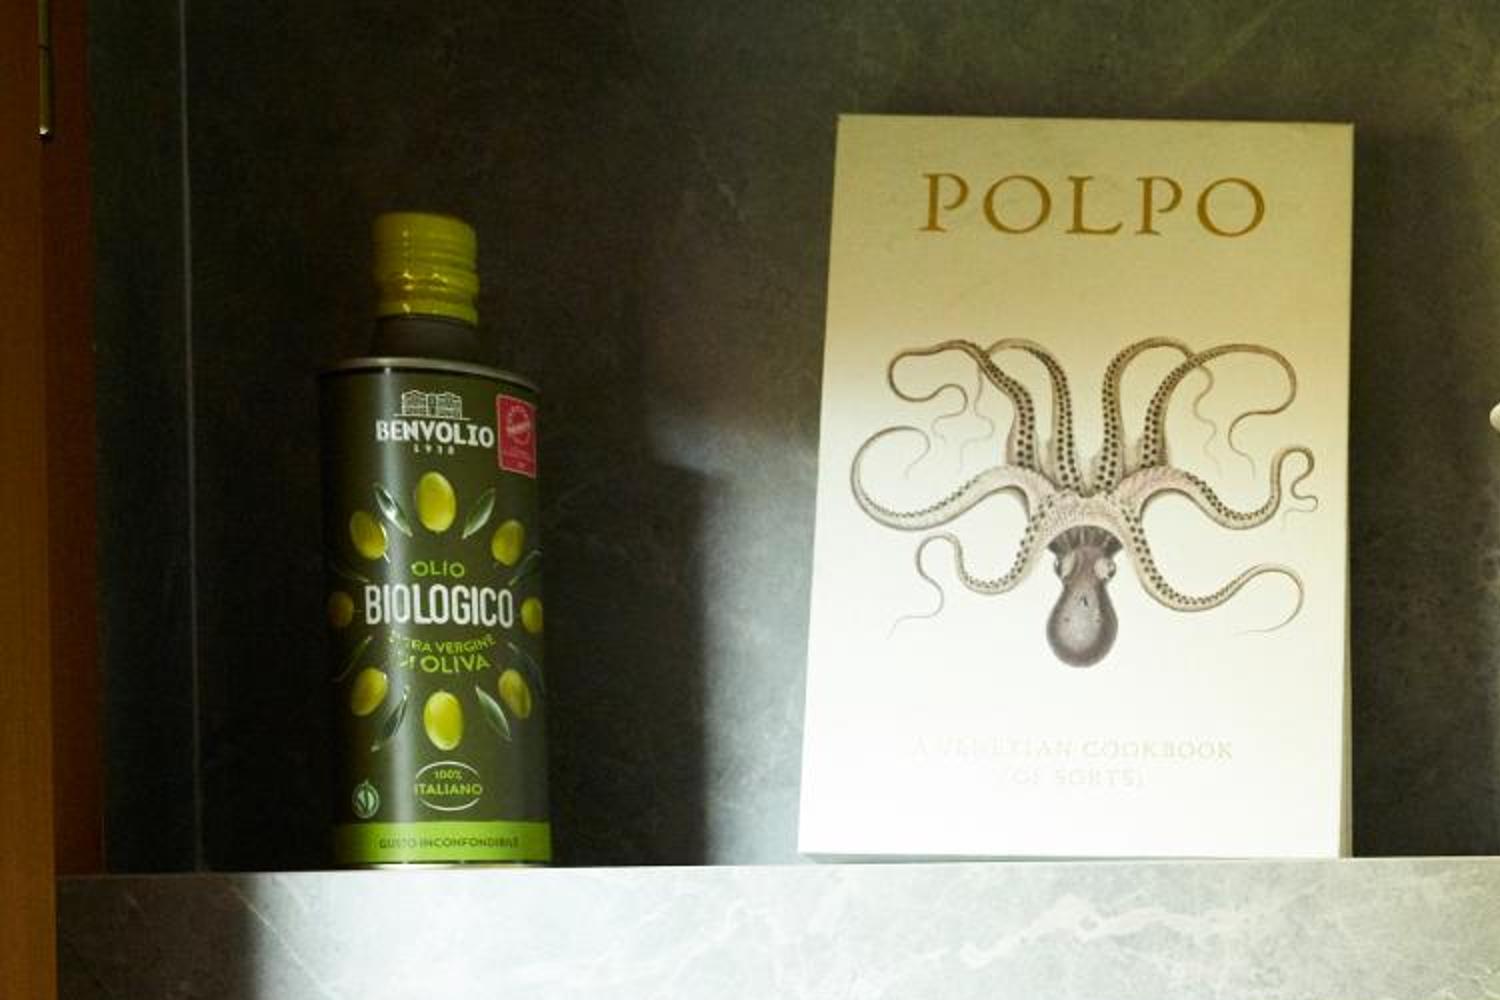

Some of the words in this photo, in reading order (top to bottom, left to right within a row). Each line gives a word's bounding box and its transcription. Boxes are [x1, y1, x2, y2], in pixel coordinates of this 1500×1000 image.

[919, 172, 1266, 238] POLPO
[375, 418, 496, 448] BENVOLIO
[411, 559, 466, 578] OLIO
[364, 583, 515, 629] BIOLOGICO
[941, 736, 1073, 758] VEETIAN
[1081, 738, 1234, 760] COOKBOOK
[433, 768, 464, 780] 100%
[415, 783, 484, 796] ITALIANO
